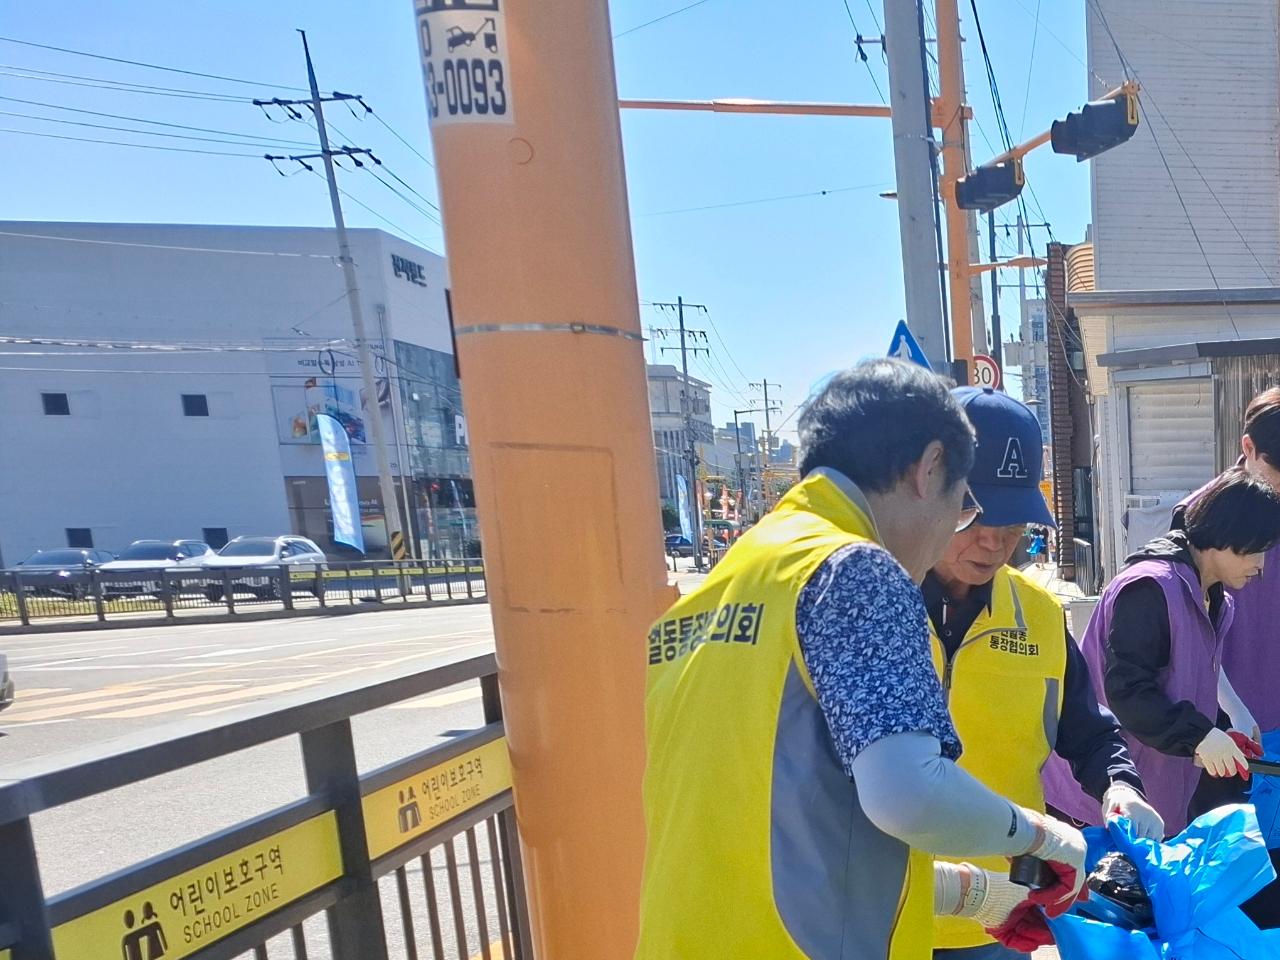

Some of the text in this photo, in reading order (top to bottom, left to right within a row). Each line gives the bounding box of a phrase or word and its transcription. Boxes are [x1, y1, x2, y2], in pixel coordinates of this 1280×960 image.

[997, 436, 1028, 478] A
[989, 635, 1039, 656] 통장협의회
[421, 755, 484, 802] 어린이보호구역
[428, 783, 481, 820] SCHOOL ZONE
[169, 844, 284, 917] 어린이보호구역
[183, 882, 280, 944] SCHOOL ZONE
